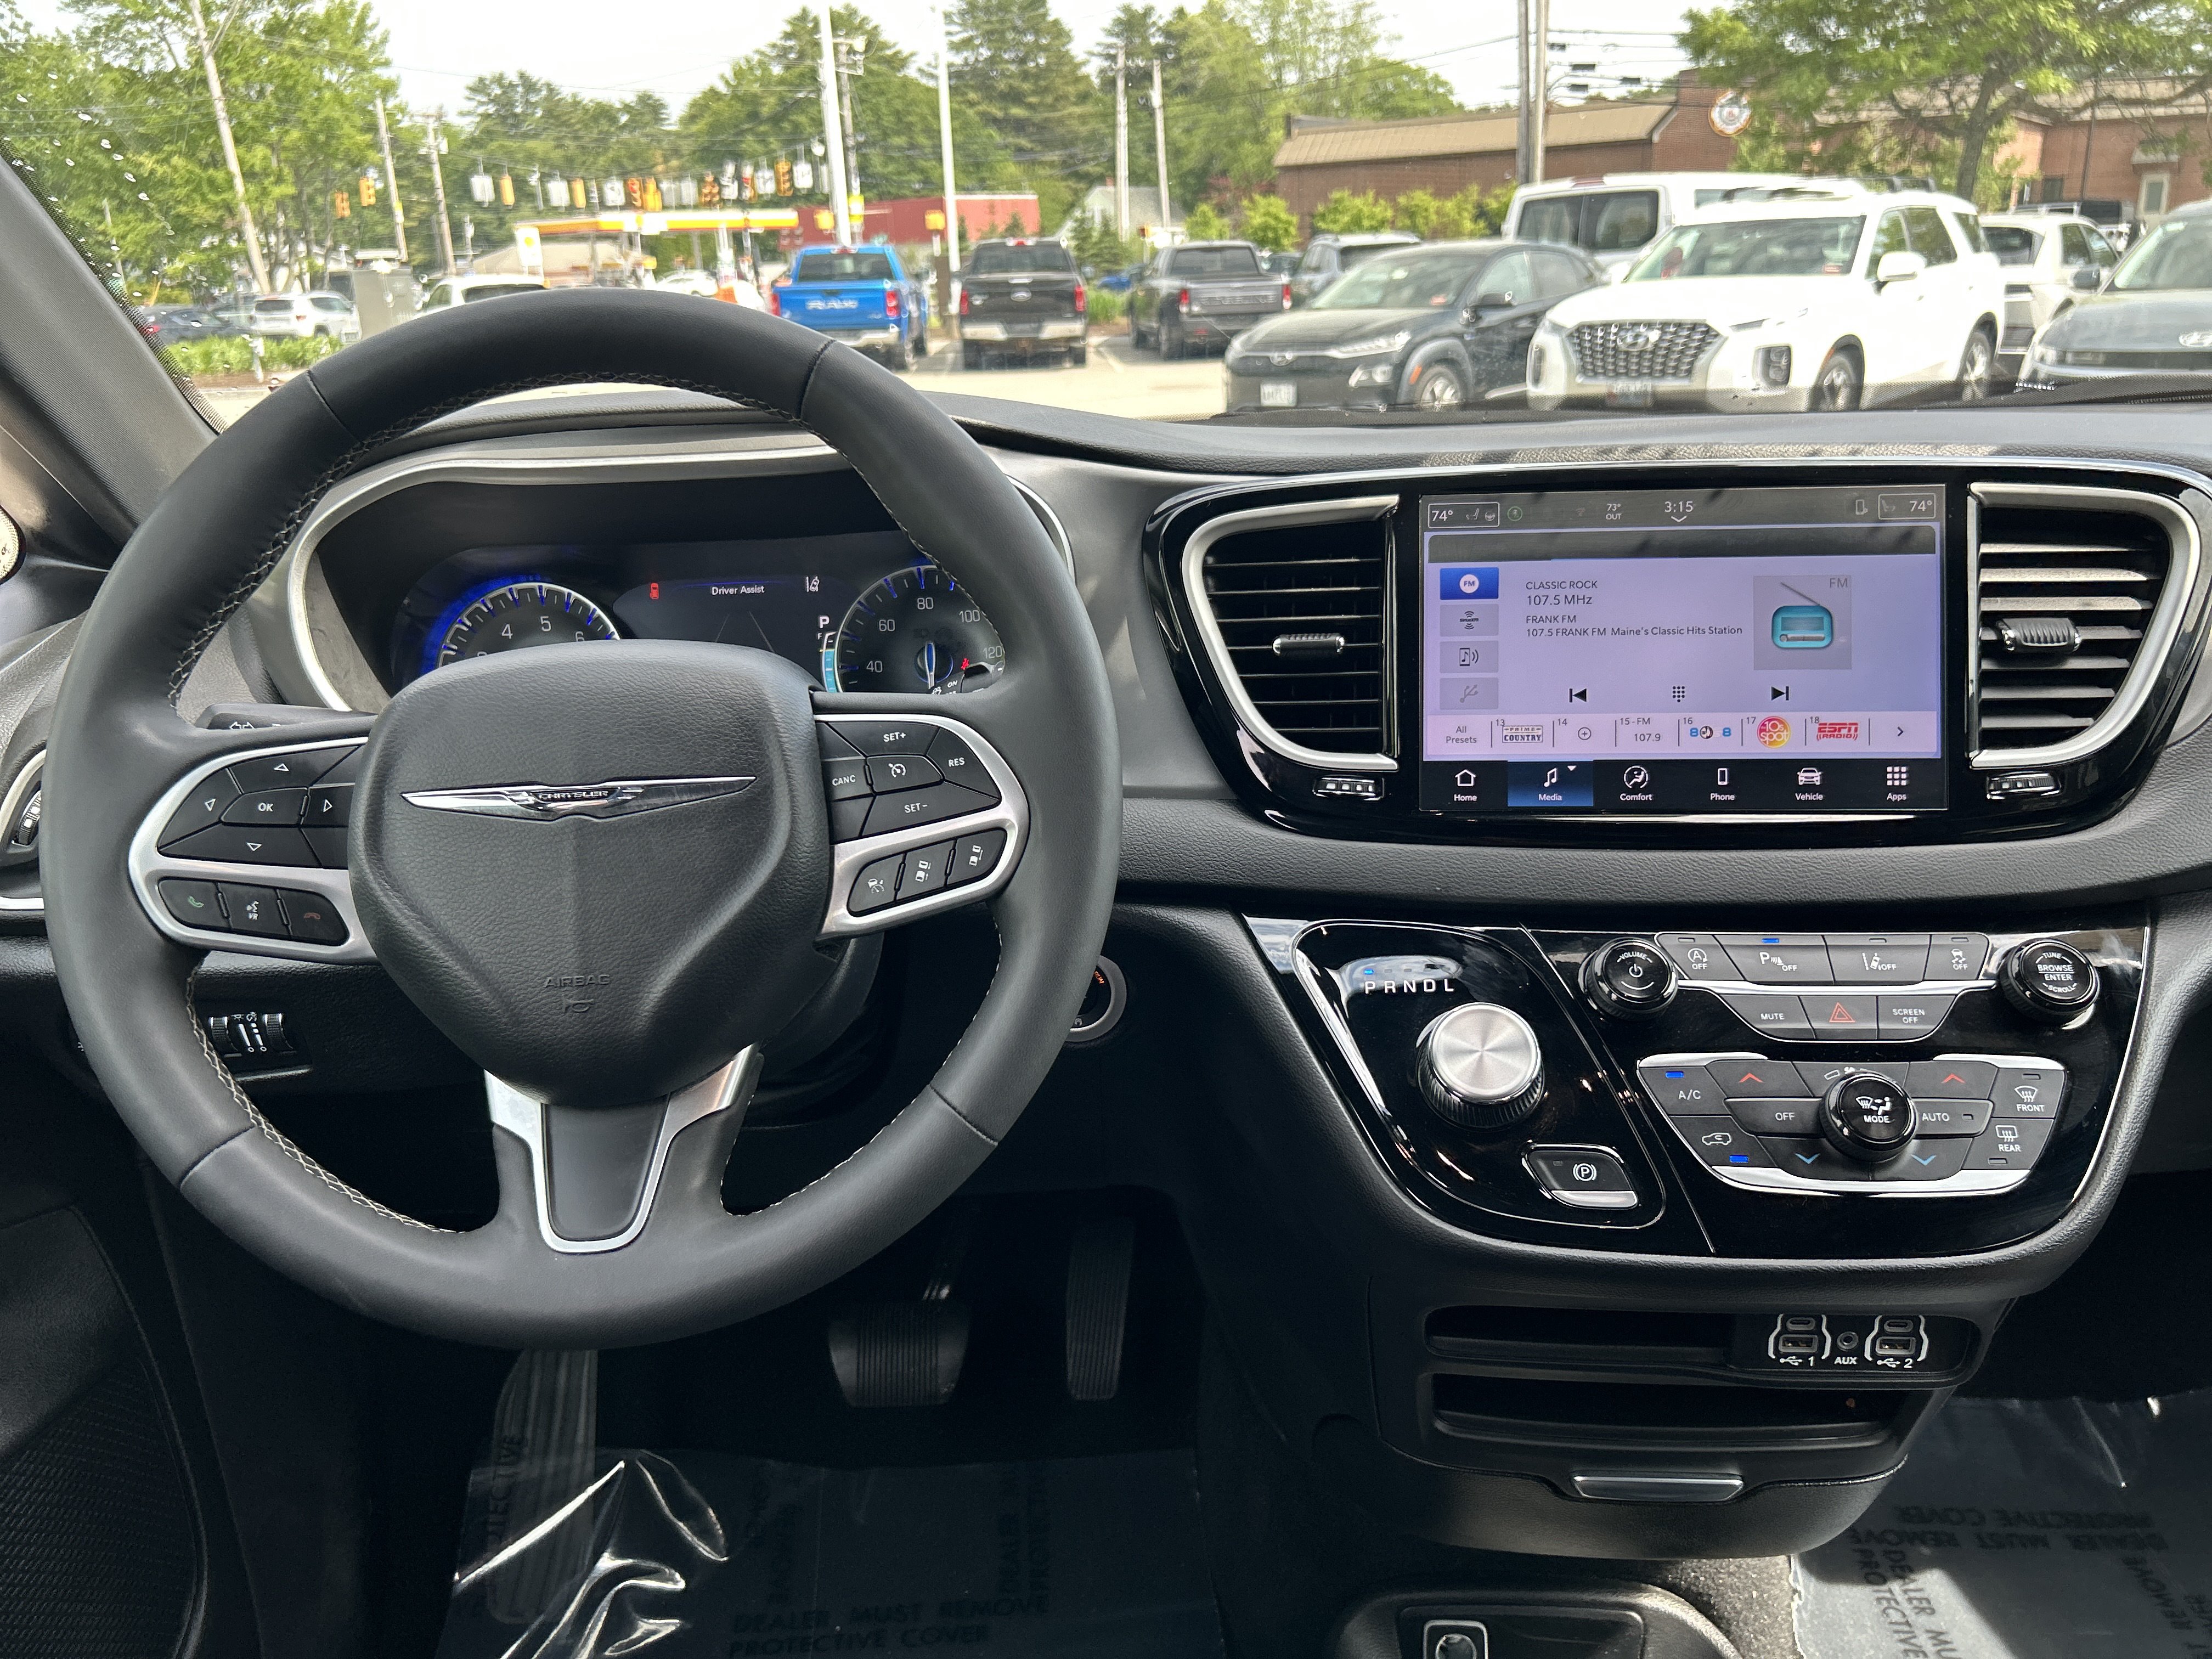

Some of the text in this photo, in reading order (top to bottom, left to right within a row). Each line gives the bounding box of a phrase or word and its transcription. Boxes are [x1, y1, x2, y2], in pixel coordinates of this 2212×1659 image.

[1664, 501, 1694, 512] 3:15
[1526, 580, 1598, 590] CLASSIC ROCK
[1829, 578, 1848, 589] FM
[712, 585, 765, 595] Driver Assist
[917, 597, 934, 610] 80
[1527, 594, 1592, 606] 107.5 MHz
[959, 610, 980, 623] 100
[1526, 615, 1576, 624] FRANK FM
[540, 616, 551, 631] 5
[819, 616, 830, 628] P
[879, 619, 895, 632] 60
[501, 623, 513, 639] 4
[1527, 625, 1742, 637] 107.5 FRANK FM Maine's Classic Hits Station
[983, 646, 1003, 659] 120
[866, 661, 883, 673] 40
[1620, 718, 1629, 726] 15
[1637, 718, 1651, 726] FM
[1818, 723, 1859, 733] ESPN
[1446, 736, 1477, 744] Presets
[1634, 733, 1661, 742] 107.9
[1760, 731, 1790, 745] spot
[948, 757, 965, 767] RES
[832, 775, 856, 786] CANC
[539, 791, 608, 799] CHRYSLER
[1454, 793, 1477, 802] Home
[1538, 793, 1562, 801] Media
[1620, 793, 1653, 801] Comfort
[1710, 793, 1735, 801] Phone
[1795, 793, 1823, 801] Vehicle
[1887, 793, 1906, 802] Apps
[258, 802, 273, 811] OK
[1619, 951, 1647, 960] VOLUME
[2038, 963, 2074, 973] BROWSE
[545, 974, 611, 989] AIRBAG
[2045, 973, 2073, 981] ENTER
[2048, 984, 2075, 994] SCROLL
[1678, 1090, 1701, 1101] A/C
[2016, 1104, 2045, 1113] FRONT
[1775, 1112, 1795, 1121] OFF
[1863, 1115, 1890, 1124] MODE
[1922, 1113, 1950, 1122] AUTO
[1998, 1144, 2021, 1153] REAR
[1808, 1356, 1814, 1367] 1
[1834, 1356, 1858, 1365] AUX
[1904, 1359, 1914, 1368] 2
[1853, 1548, 1929, 1659] PROTECTIVE
[1882, 1549, 1963, 1659] DEALER MU
[732, 1595, 1049, 1634] DEALER MUST REMOVE
[729, 1624, 988, 1658] PROTECTIVE COVER
